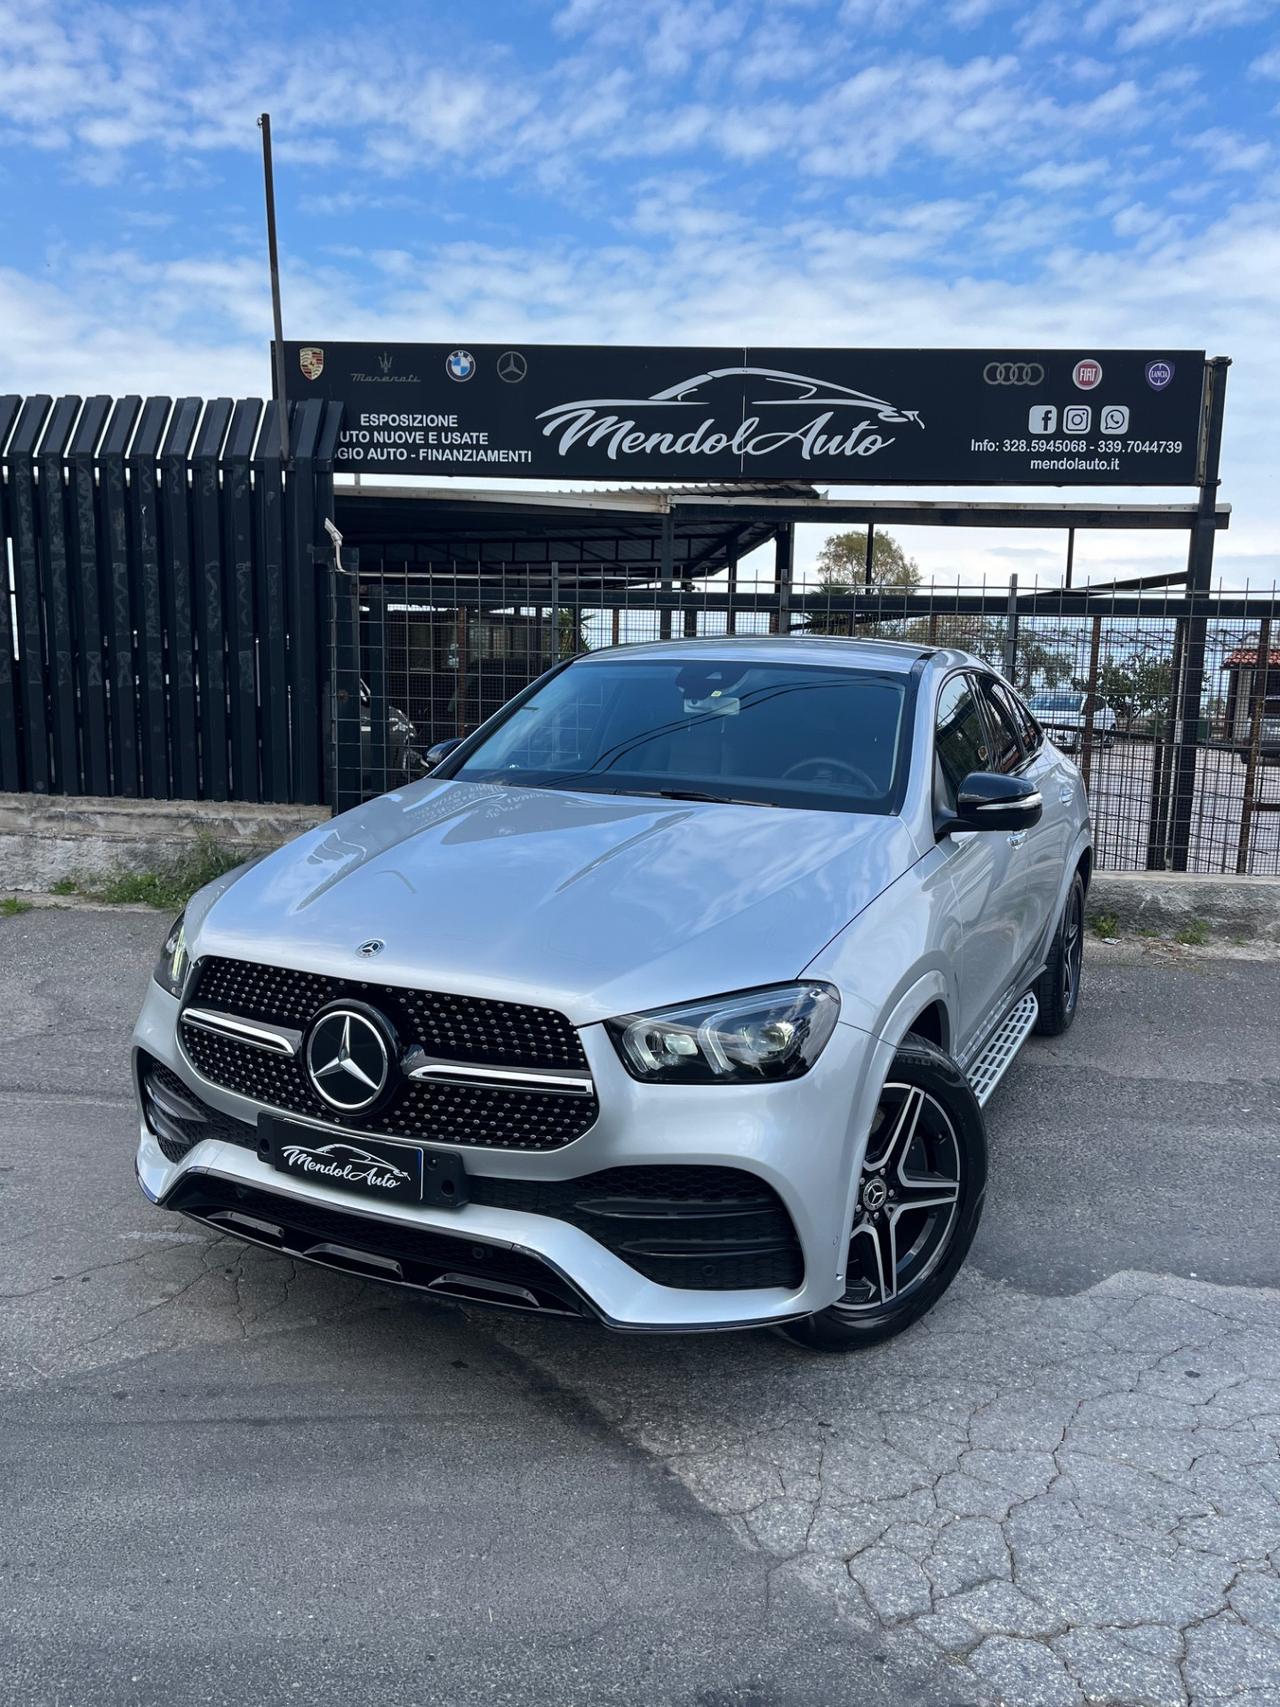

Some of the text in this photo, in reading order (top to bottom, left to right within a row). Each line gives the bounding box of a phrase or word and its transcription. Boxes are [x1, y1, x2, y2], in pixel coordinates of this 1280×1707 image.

[1079, 367, 1097, 382] FIAT
[360, 413, 459, 428] ESPOSIZIONE
[340, 430, 489, 445] UTO NUOVE E USATE
[970, 438, 1000, 452] Info:
[1002, 439, 1087, 453] 328.5945068
[1097, 440, 1183, 454] 339.7044739
[335, 447, 364, 460] GIO
[367, 447, 408, 461] AUTO
[419, 448, 532, 463] FINANZIAMENTI
[1030, 457, 1120, 471] mendolauto.it
